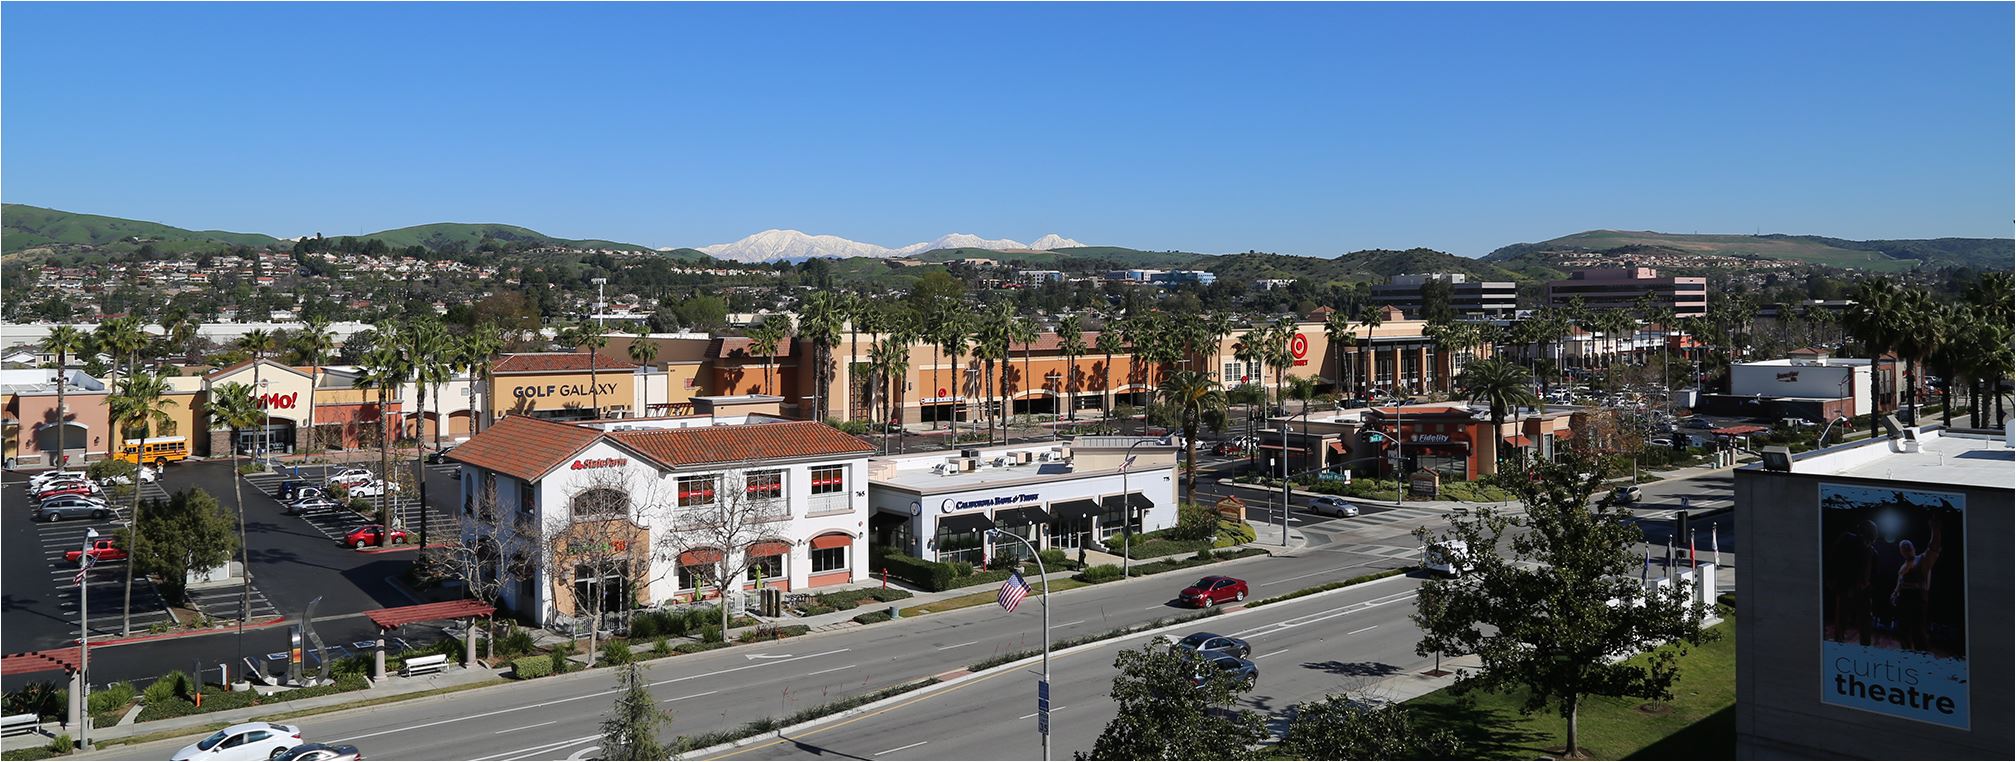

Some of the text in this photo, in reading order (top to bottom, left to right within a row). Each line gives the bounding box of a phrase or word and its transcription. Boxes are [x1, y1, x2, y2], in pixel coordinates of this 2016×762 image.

[513, 383, 617, 398] GOLF GALAXY
[1419, 434, 1449, 442] Fidelity
[1835, 656, 1919, 686] curtis
[1835, 673, 1955, 715] theatre
